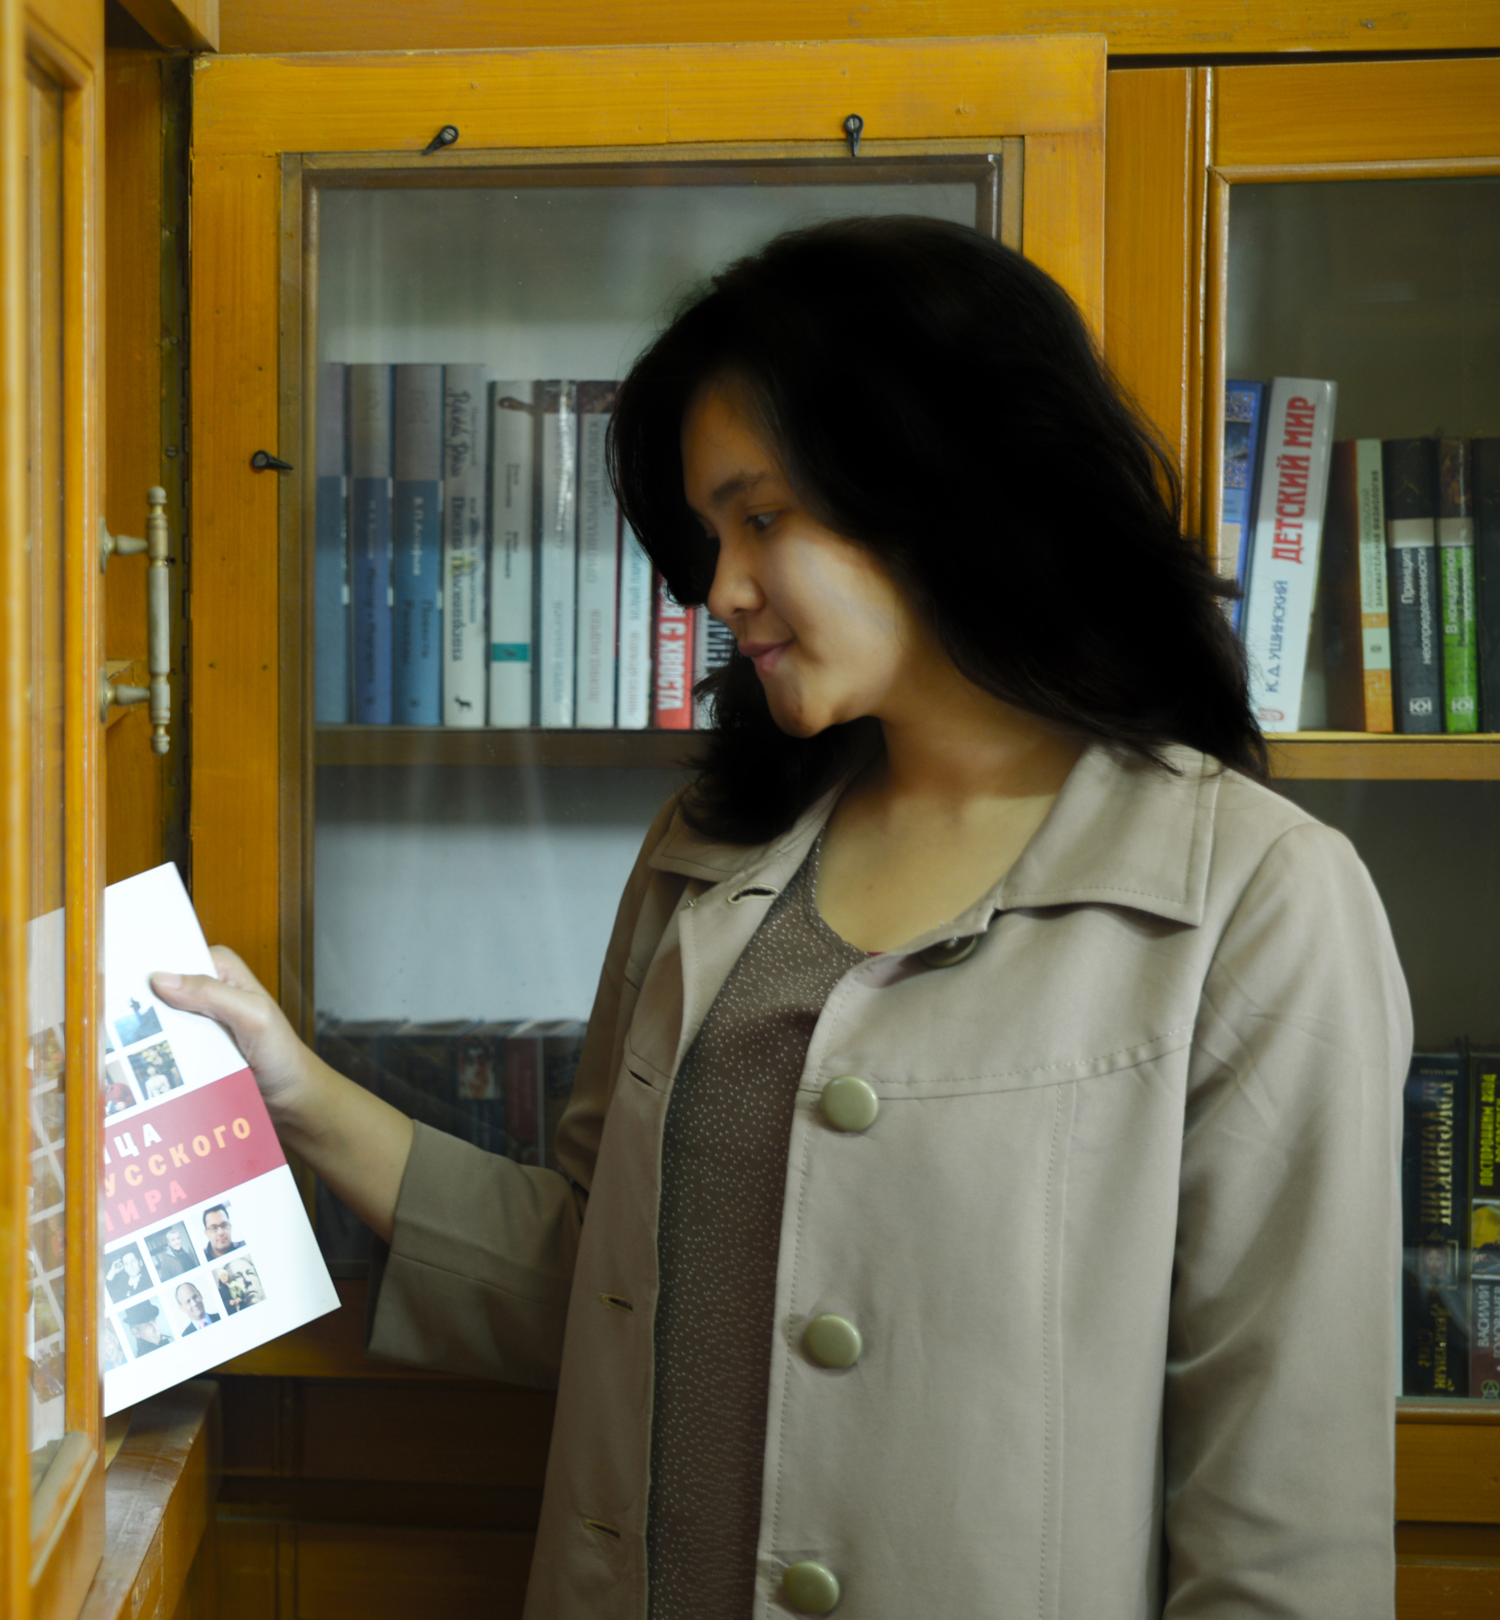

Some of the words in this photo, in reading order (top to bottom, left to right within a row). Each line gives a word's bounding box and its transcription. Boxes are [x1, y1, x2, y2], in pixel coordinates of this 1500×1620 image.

[1283, 396, 1316, 449] МИР
[1272, 453, 1311, 565] ДЕТСКИЙ
[1401, 548, 1414, 603] Принцип
[1417, 548, 1432, 665] неопределенности
[1445, 548, 1458, 622] концертном
[1270, 580, 1288, 661] УШИНСКИЙ
[1445, 624, 1458, 634] В
[657, 639, 687, 711] ХВОСТА
[104, 1122, 163, 1165] ЦА
[104, 1117, 251, 1198] УССКОГО
[1476, 1284, 1490, 1348] ВАСИЛИЙ
